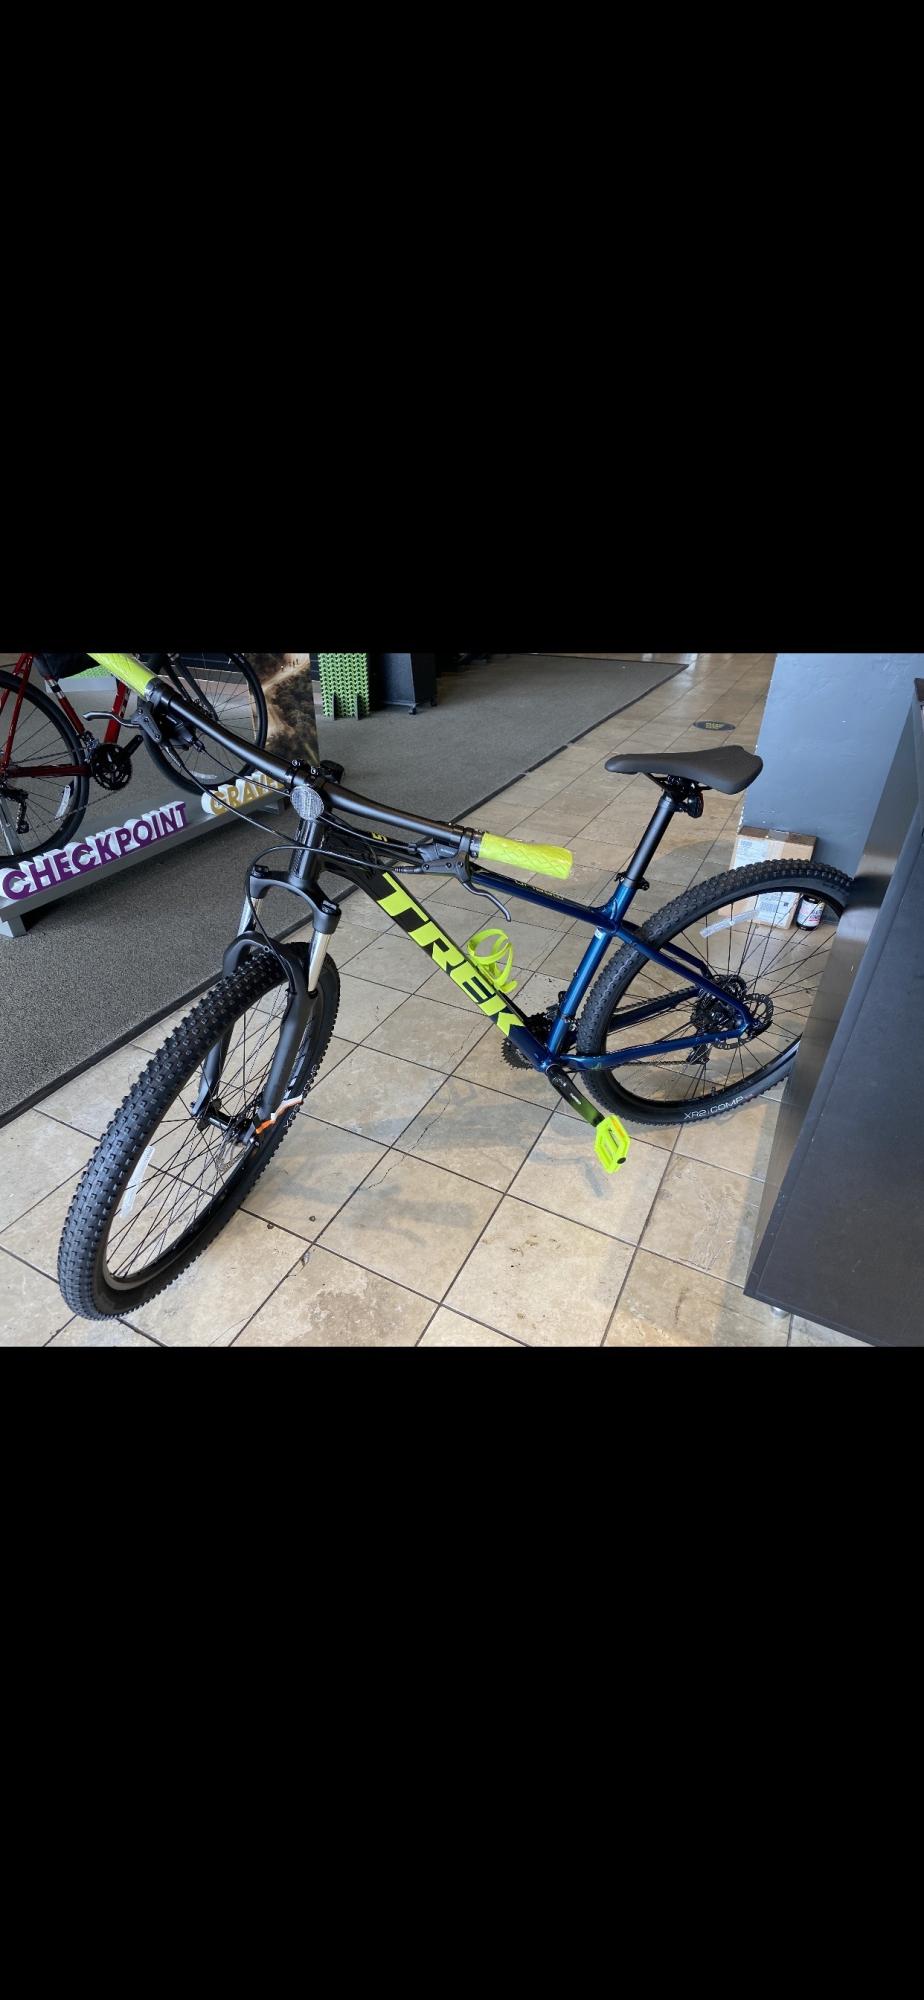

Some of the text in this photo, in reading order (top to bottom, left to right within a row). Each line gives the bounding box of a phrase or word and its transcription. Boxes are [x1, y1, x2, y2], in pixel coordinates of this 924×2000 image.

[1, 801, 188, 900] CHECKPOINT
[376, 871, 525, 1037] TREK
[684, 1095, 744, 1120] XR2 COMP
